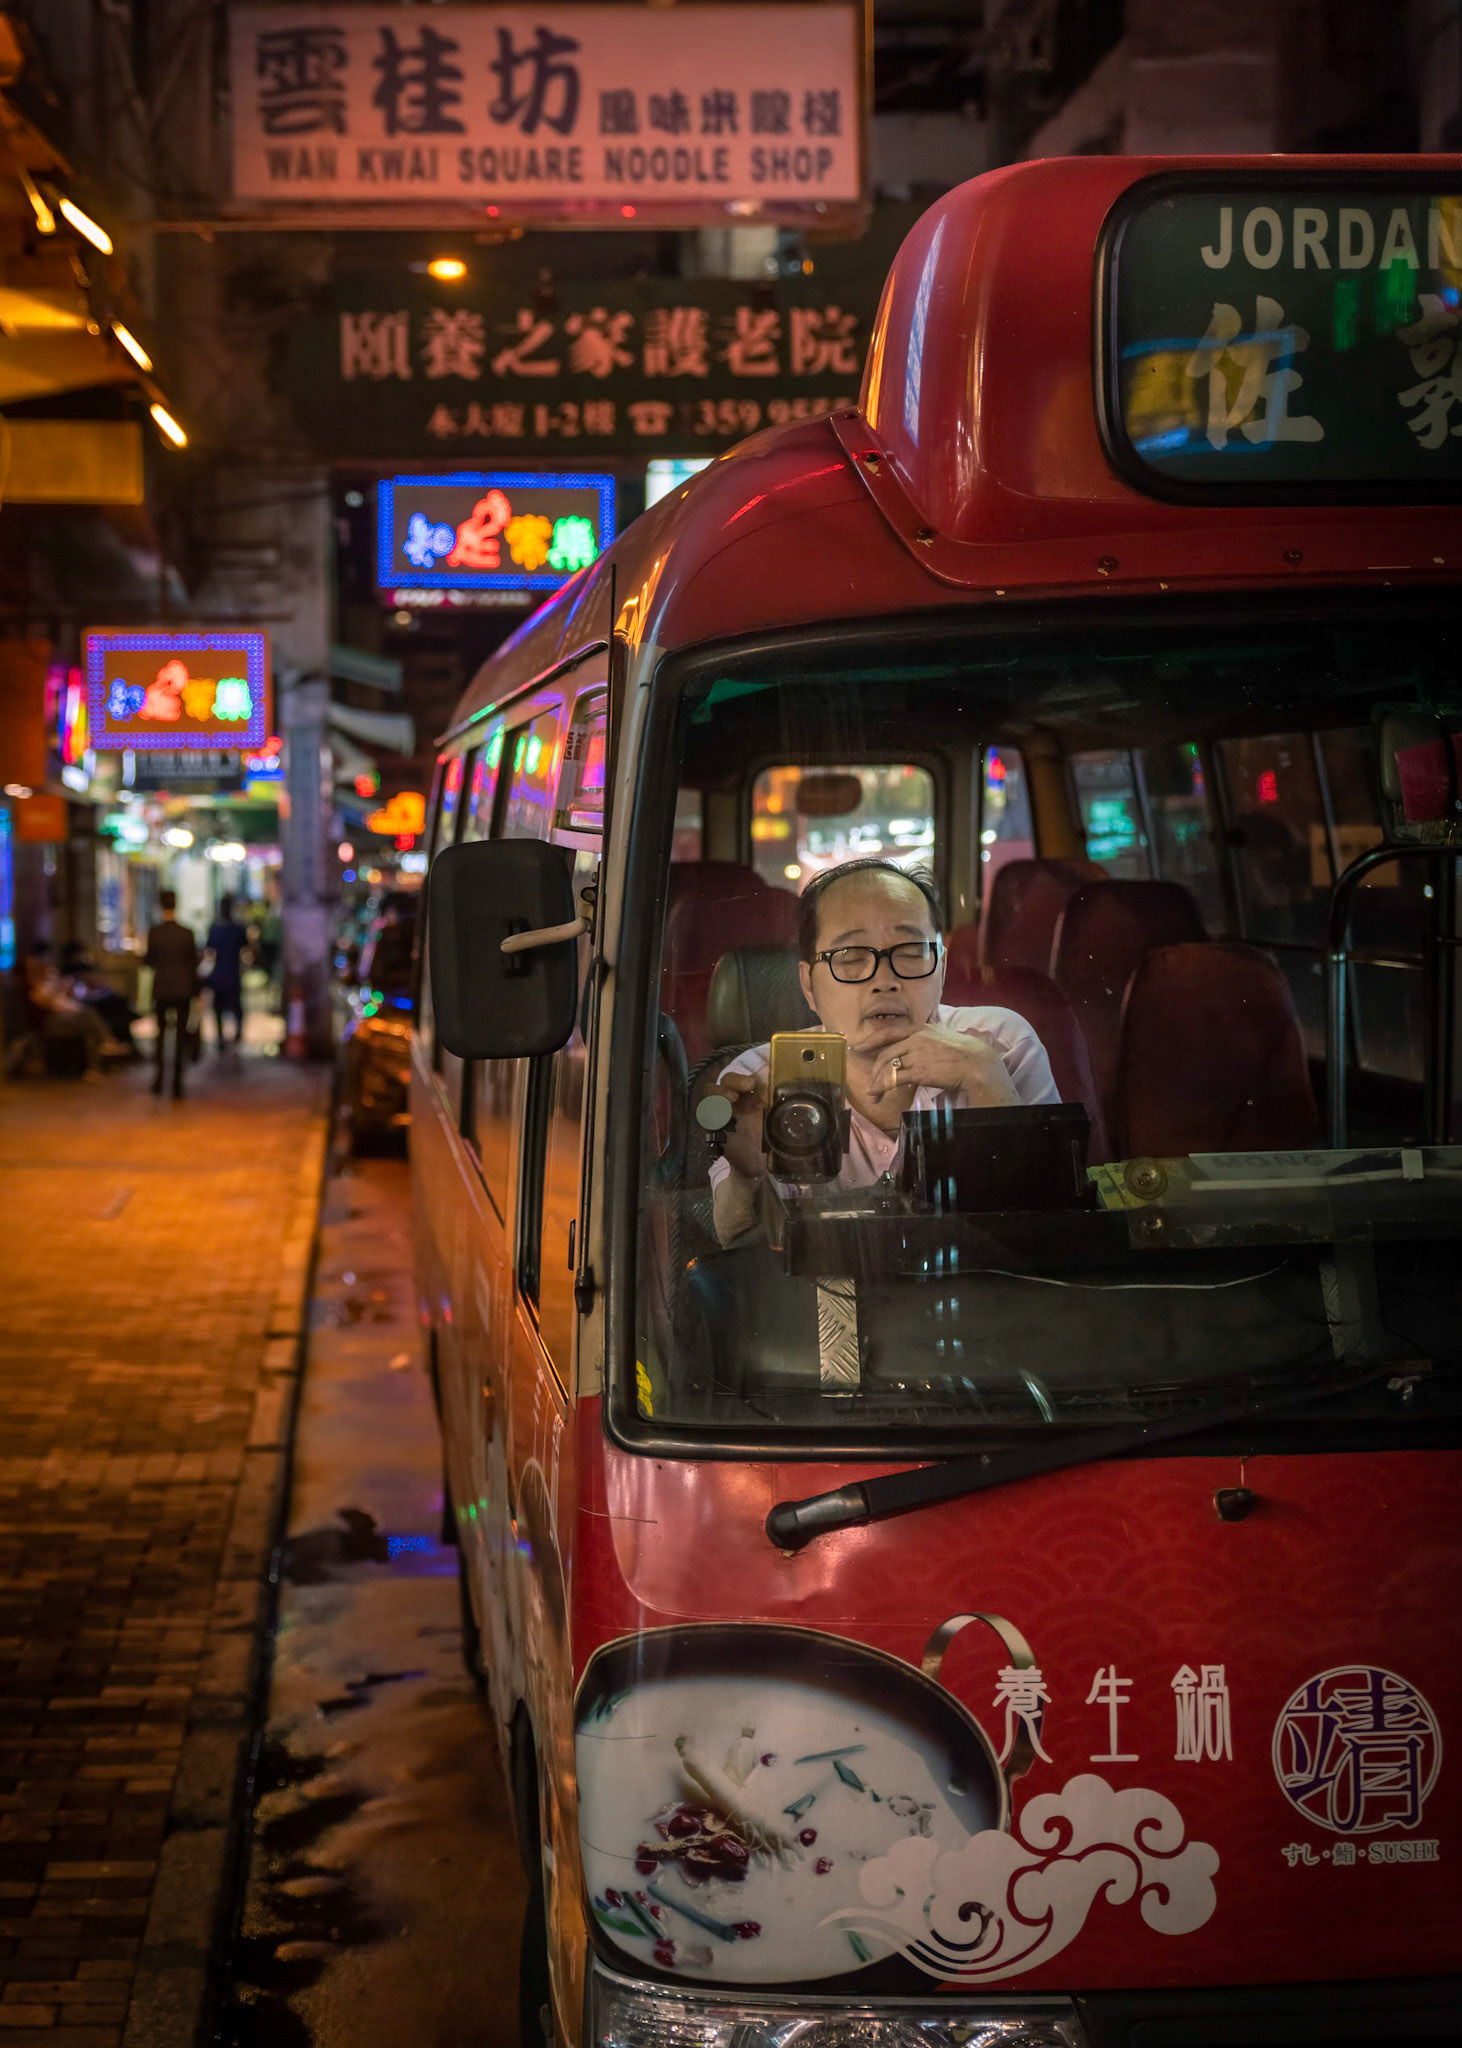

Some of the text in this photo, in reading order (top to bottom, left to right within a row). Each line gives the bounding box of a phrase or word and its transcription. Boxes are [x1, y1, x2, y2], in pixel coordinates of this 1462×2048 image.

[256, 26, 582, 138] 雲桂坊
[266, 146, 833, 184] WAN KWAI SQUARE NOODLE SHOP
[1201, 206, 1462, 270] JORDAN
[992, 1664, 1234, 1764] 養生鍋
